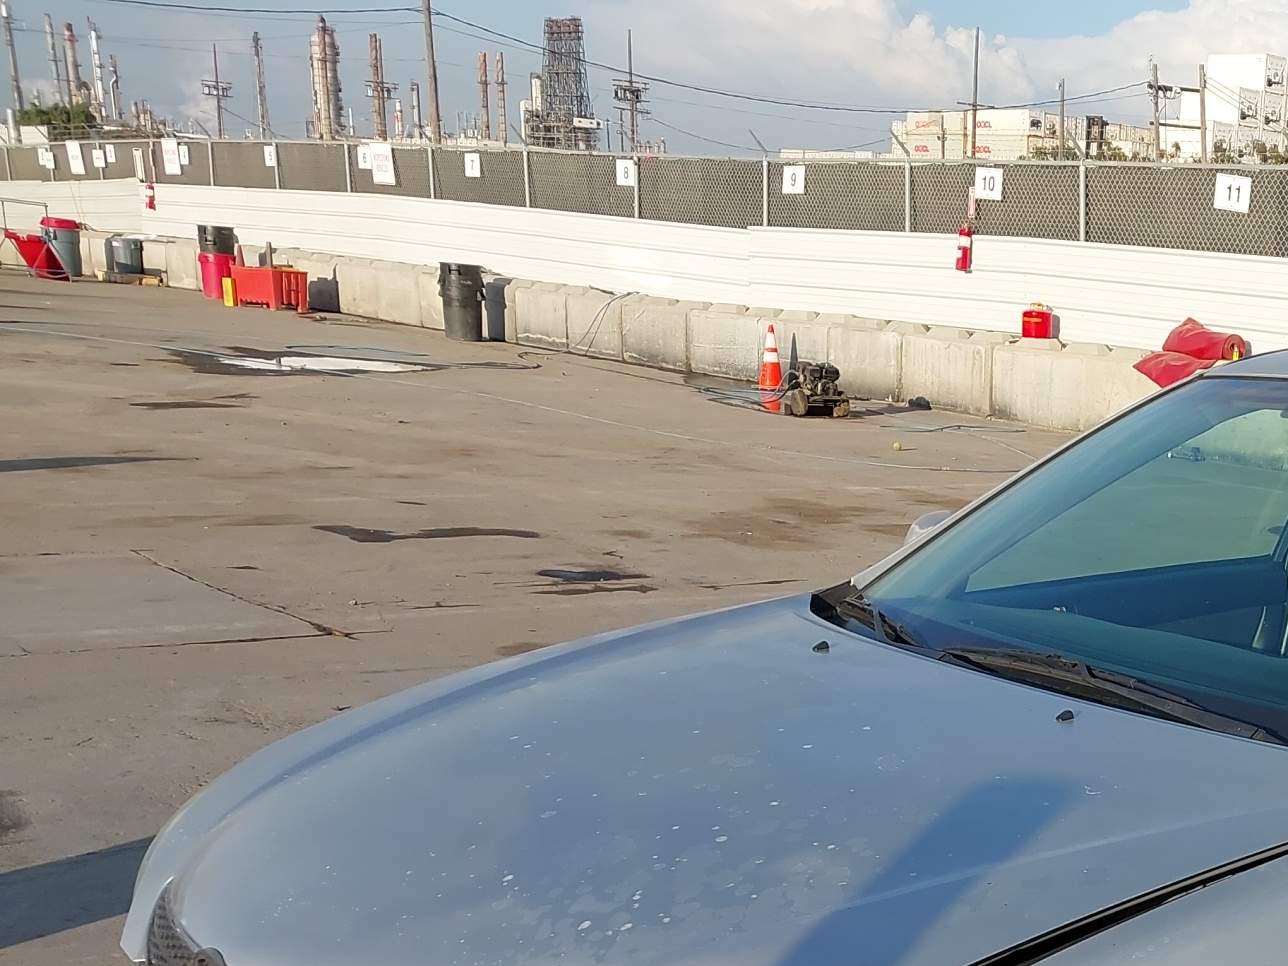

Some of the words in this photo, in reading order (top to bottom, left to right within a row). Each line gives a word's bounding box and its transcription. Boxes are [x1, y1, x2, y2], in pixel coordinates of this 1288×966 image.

[470, 159, 475, 170] 7
[623, 166, 629, 180] 8
[790, 172, 797, 187] 9
[981, 175, 995, 192] 10
[1226, 183, 1241, 203] 11
